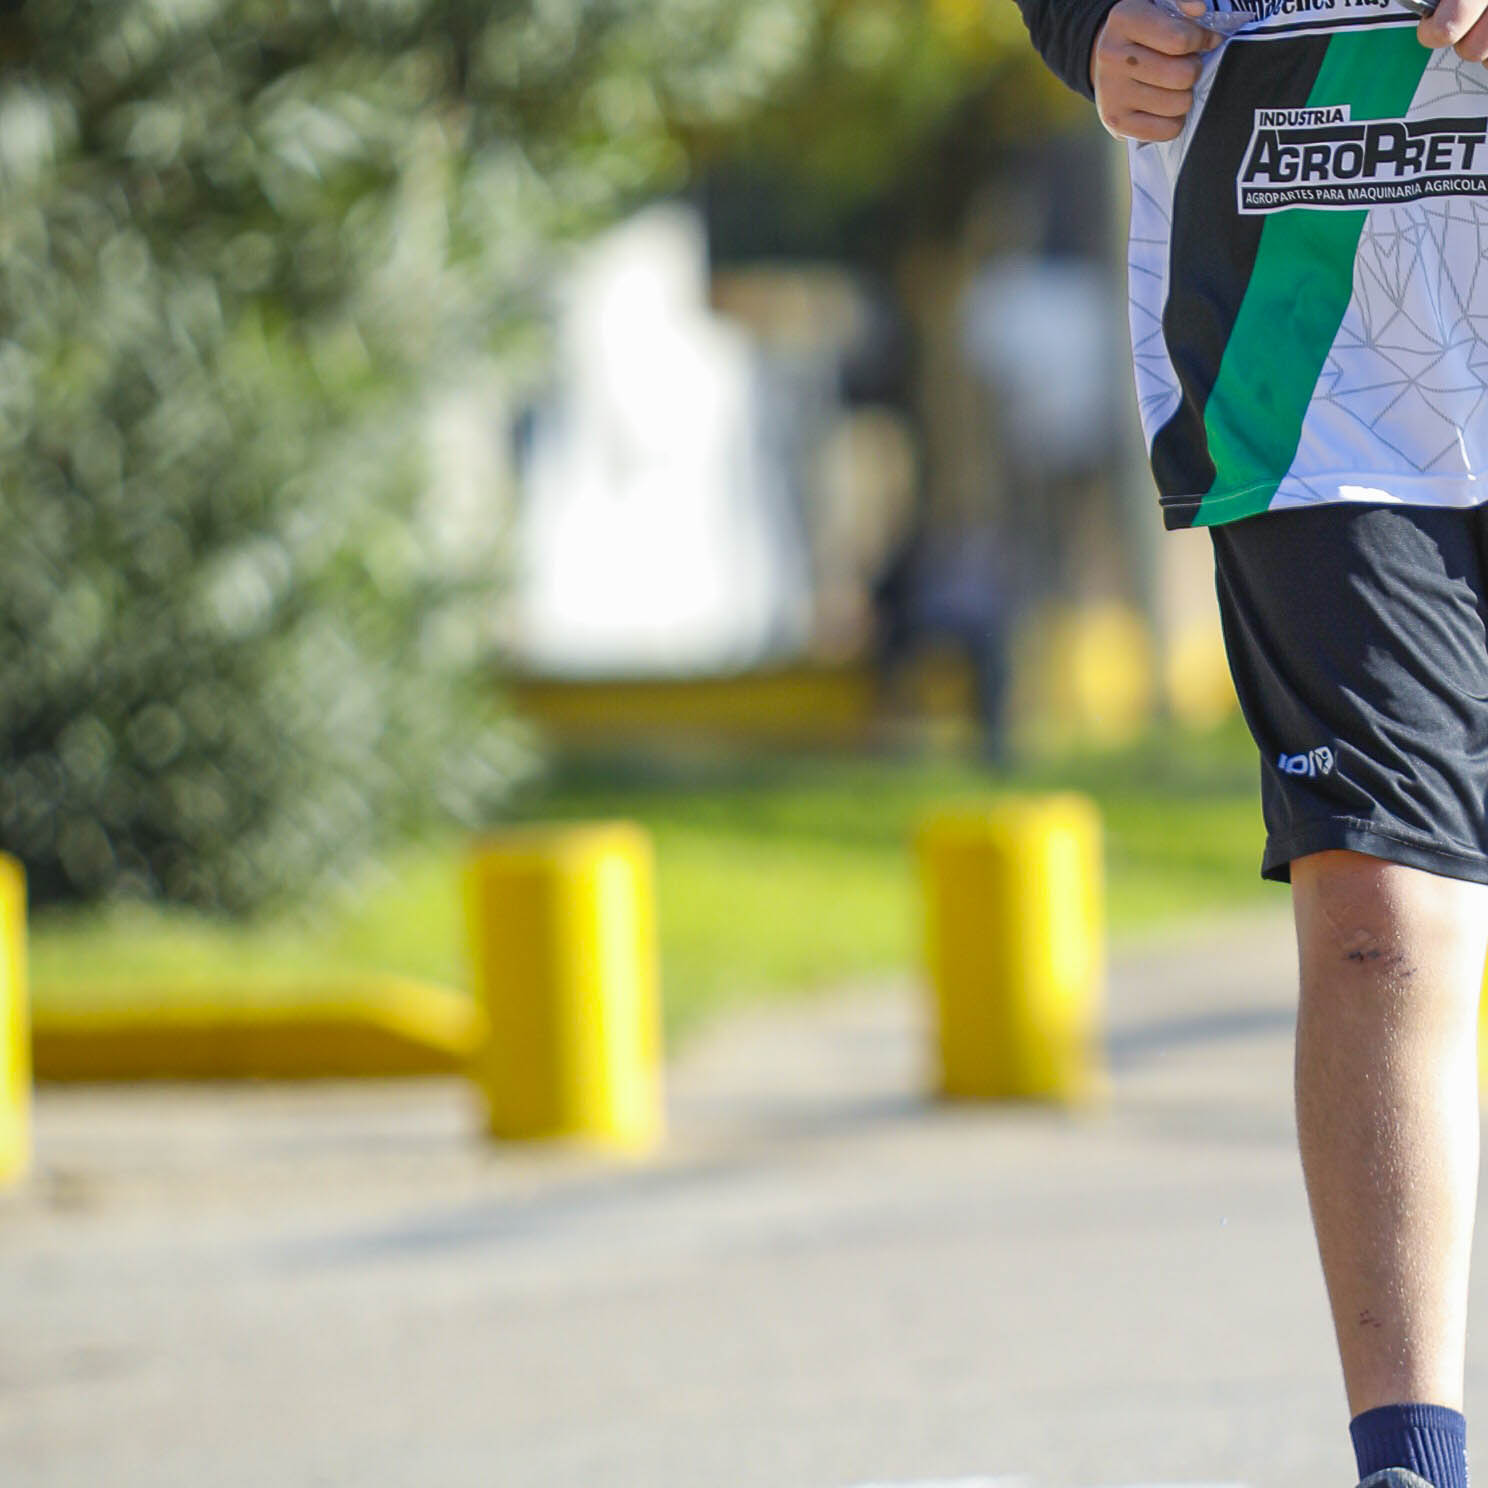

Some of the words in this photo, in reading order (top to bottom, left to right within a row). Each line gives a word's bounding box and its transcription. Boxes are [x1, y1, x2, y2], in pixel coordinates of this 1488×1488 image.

[1260, 108, 1344, 127] INDUSTRIA
[1245, 189, 1314, 204] AGROPARTES
[1316, 189, 1346, 201] PARA
[1347, 183, 1422, 200] MAQUINARIA
[1424, 179, 1487, 193] AGRICOLA
